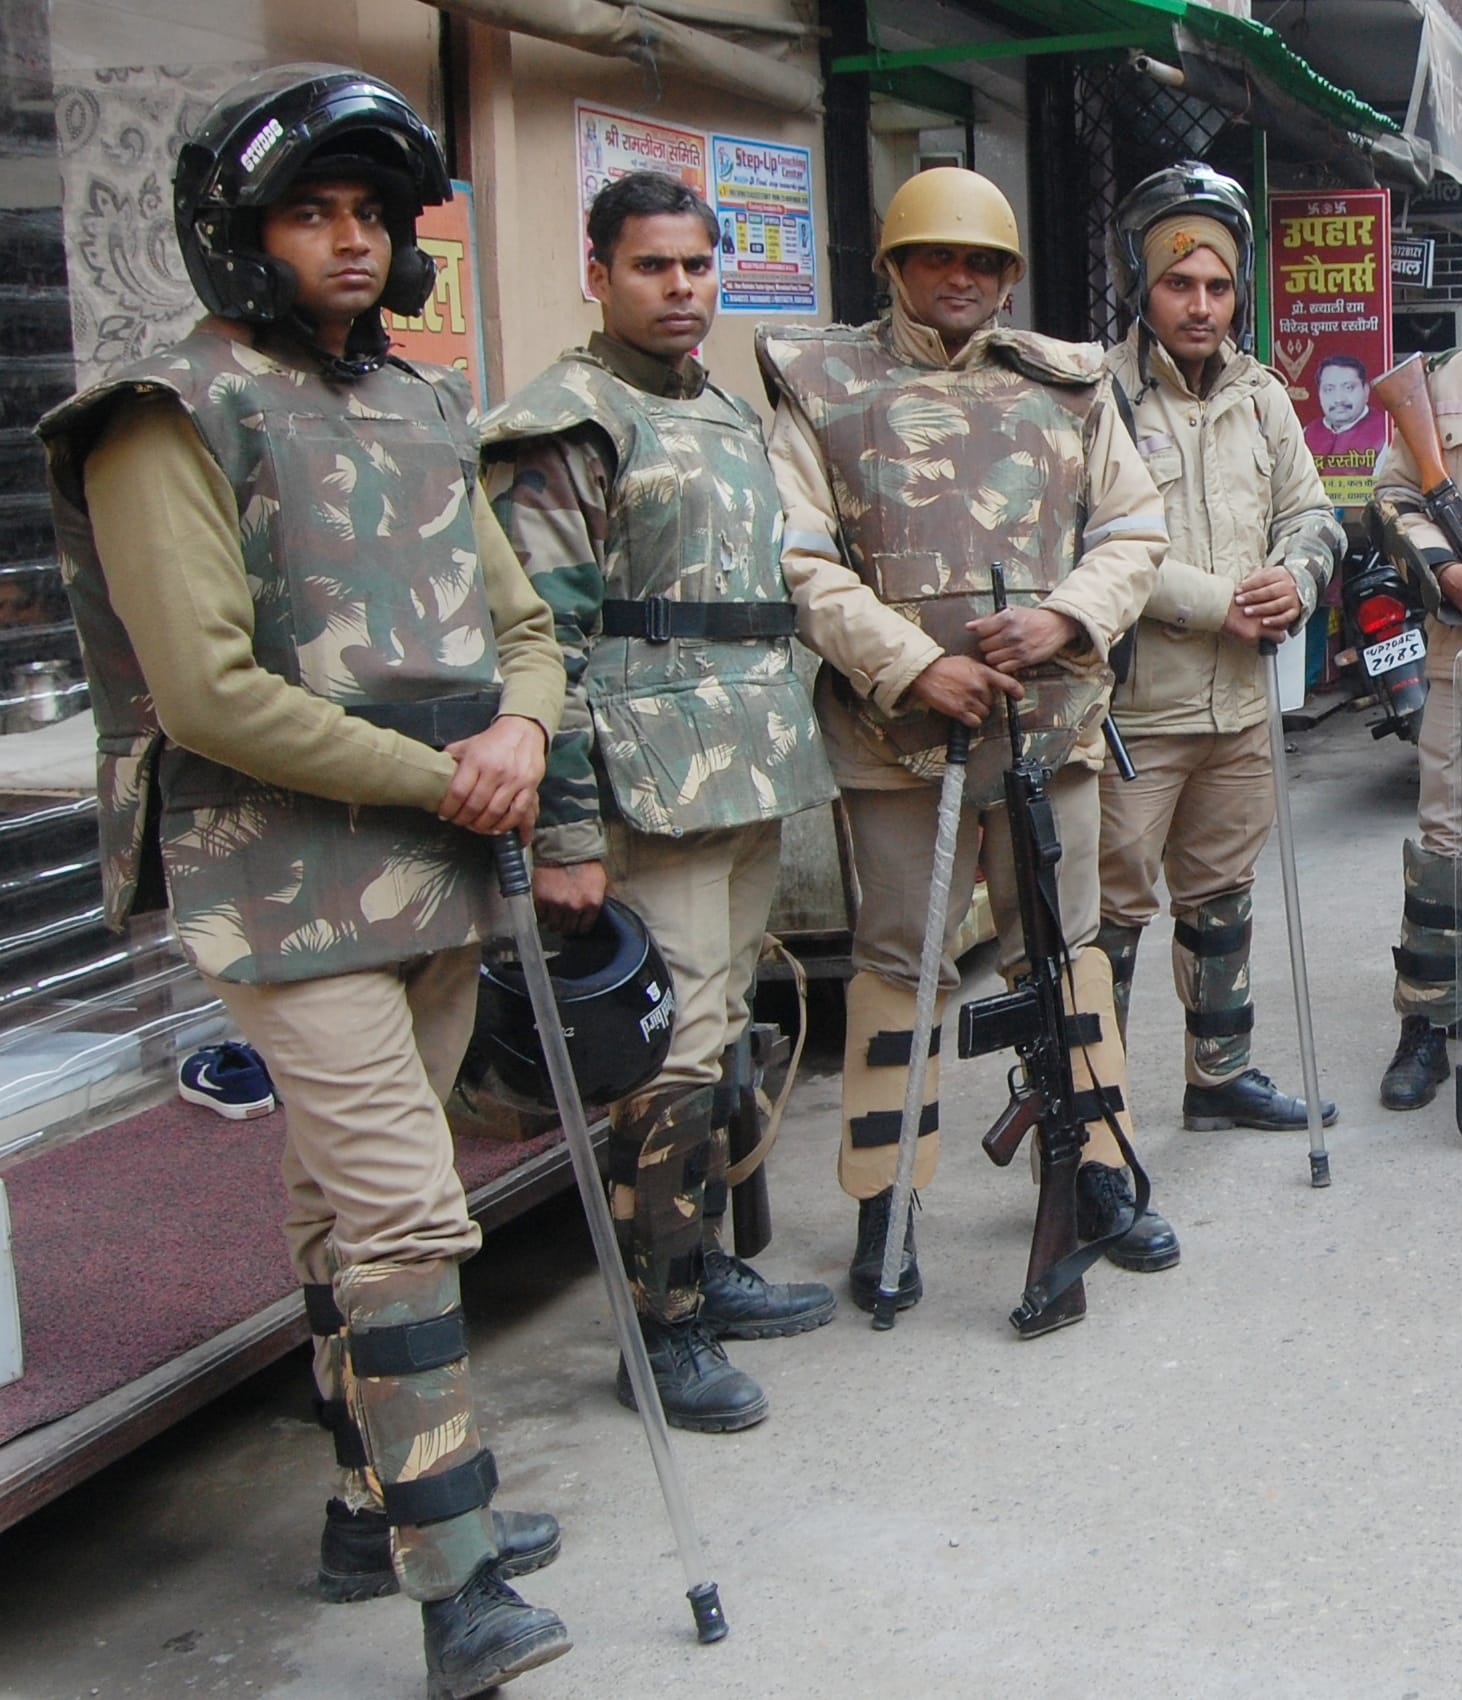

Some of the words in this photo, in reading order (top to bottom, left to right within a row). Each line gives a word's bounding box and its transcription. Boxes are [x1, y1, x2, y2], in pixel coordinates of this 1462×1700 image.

[605, 123, 619, 148] श्री
[622, 133, 665, 160] रामलीला
[668, 140, 700, 167] समिति
[1280, 216, 1375, 248] उपहार
[1280, 253, 1376, 293] ज्वैलर्स
[1391, 260, 1422, 275] वाल
[1346, 302, 1364, 313] राम
[1310, 320, 1339, 336] कुमार
[1328, 448, 1375, 469] रस्तोगी
[1372, 643, 1419, 671] 2985
